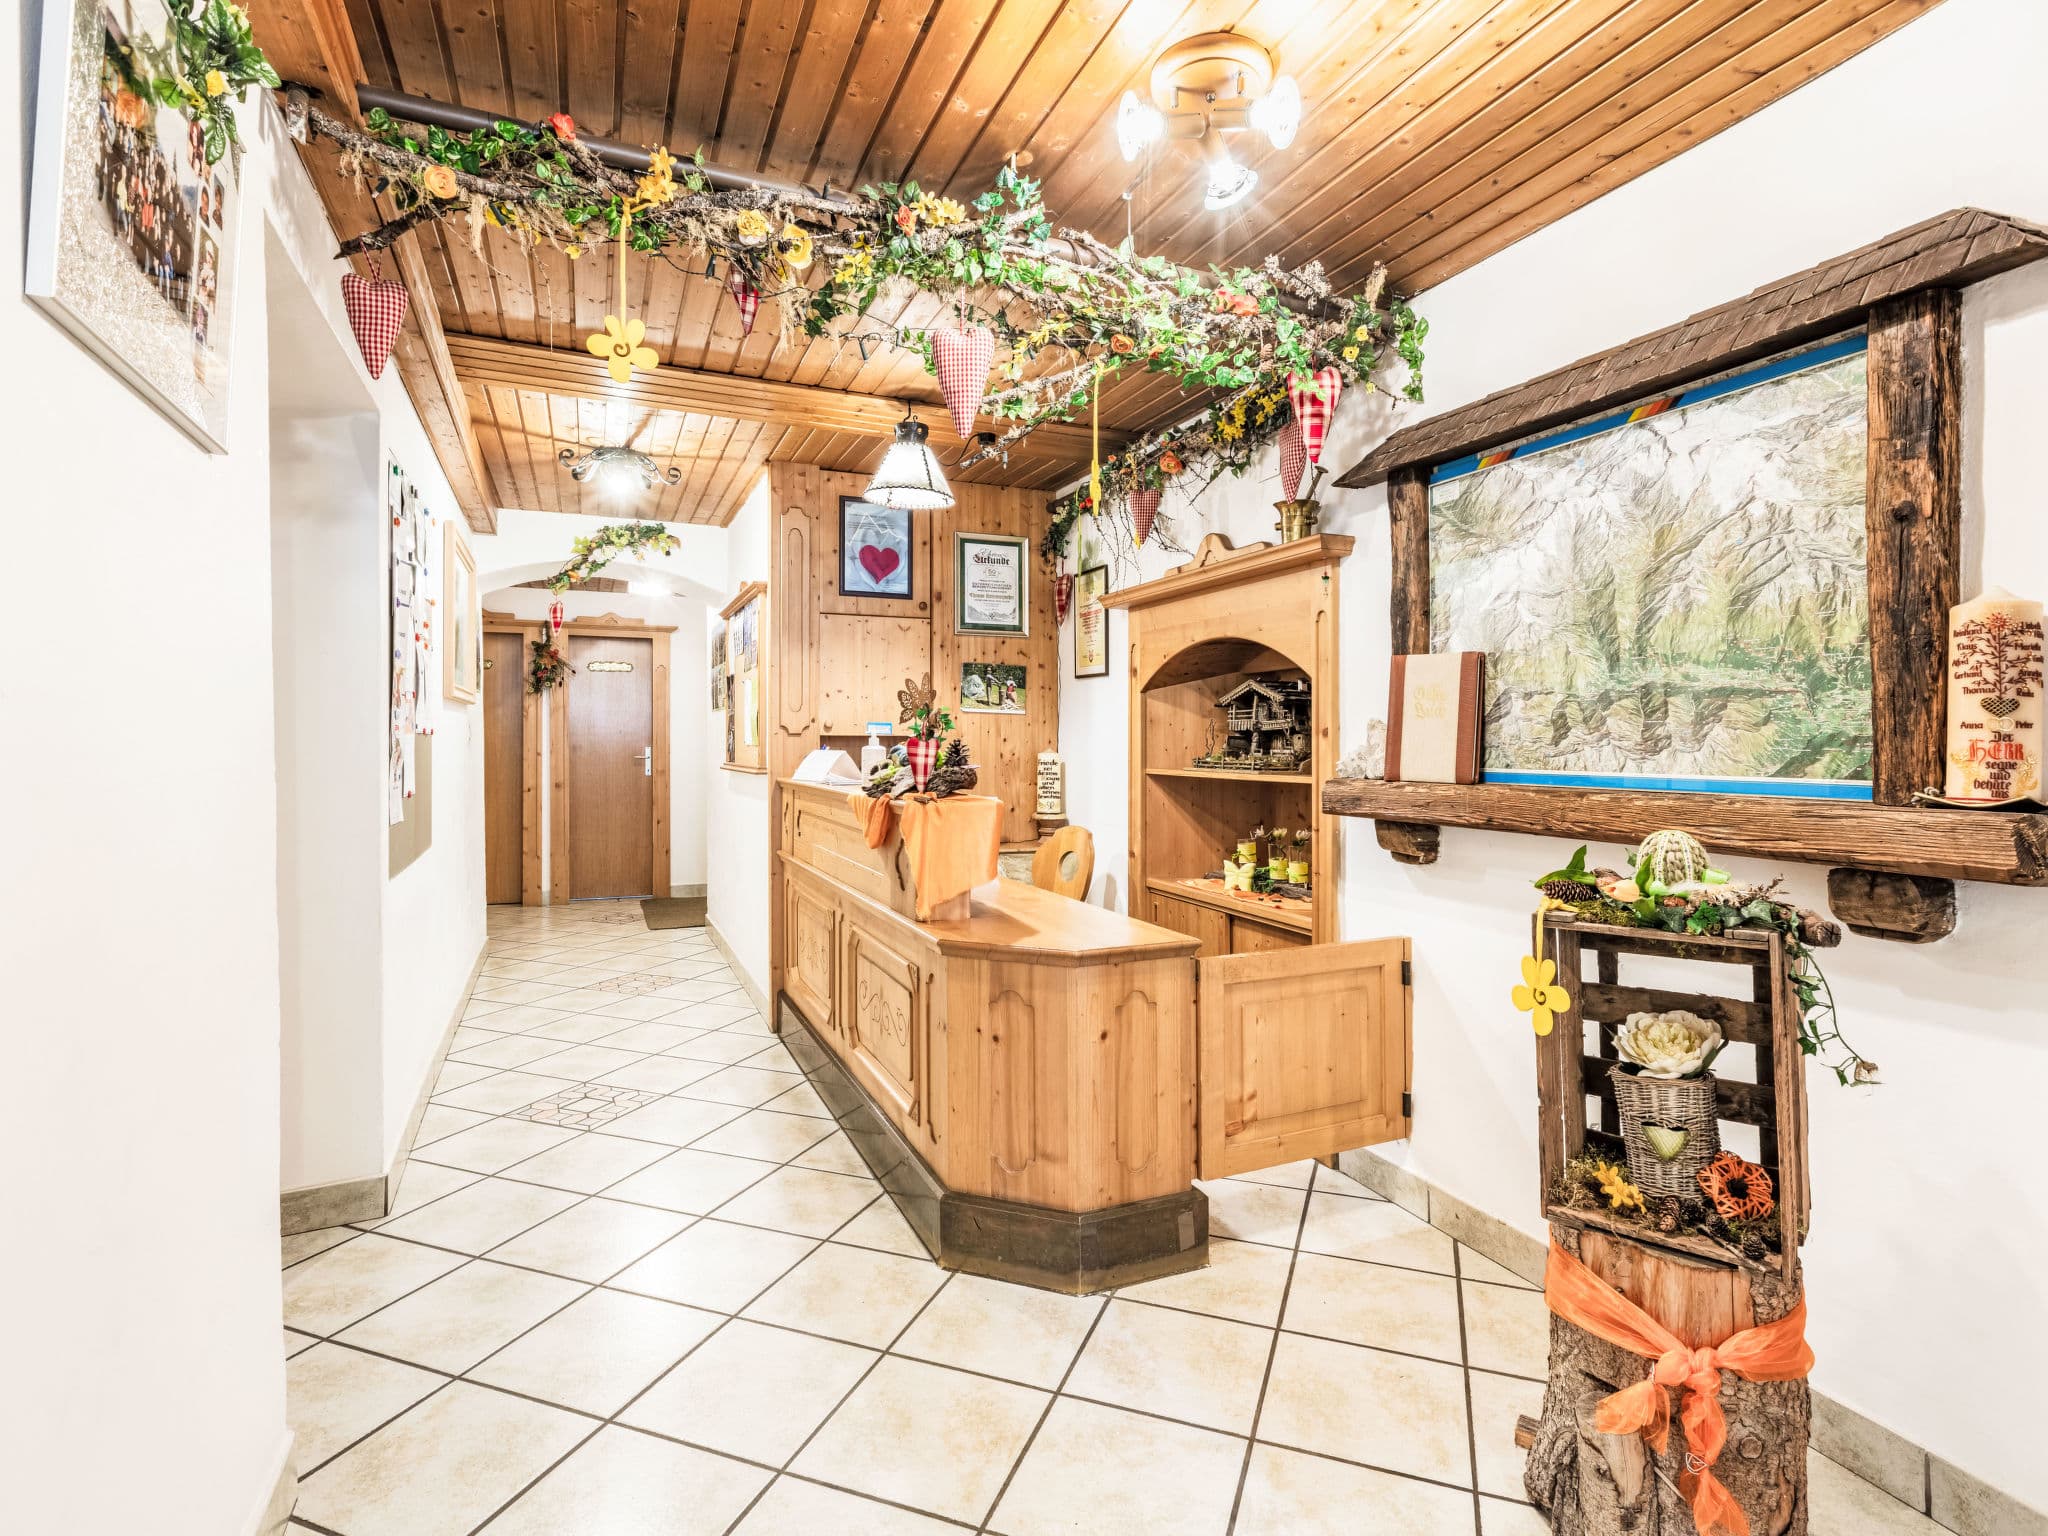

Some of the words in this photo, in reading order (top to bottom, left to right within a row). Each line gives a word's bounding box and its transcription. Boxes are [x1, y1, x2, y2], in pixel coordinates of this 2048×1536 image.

[1962, 686, 1997, 695] Thomas
[1960, 721, 1984, 730] Anna
[2015, 720, 2034, 729] Peter
[1989, 730, 2014, 743] Der
[1985, 760, 2018, 772] segne
[1989, 769, 2011, 781] und
[1991, 789, 2010, 799] uns
